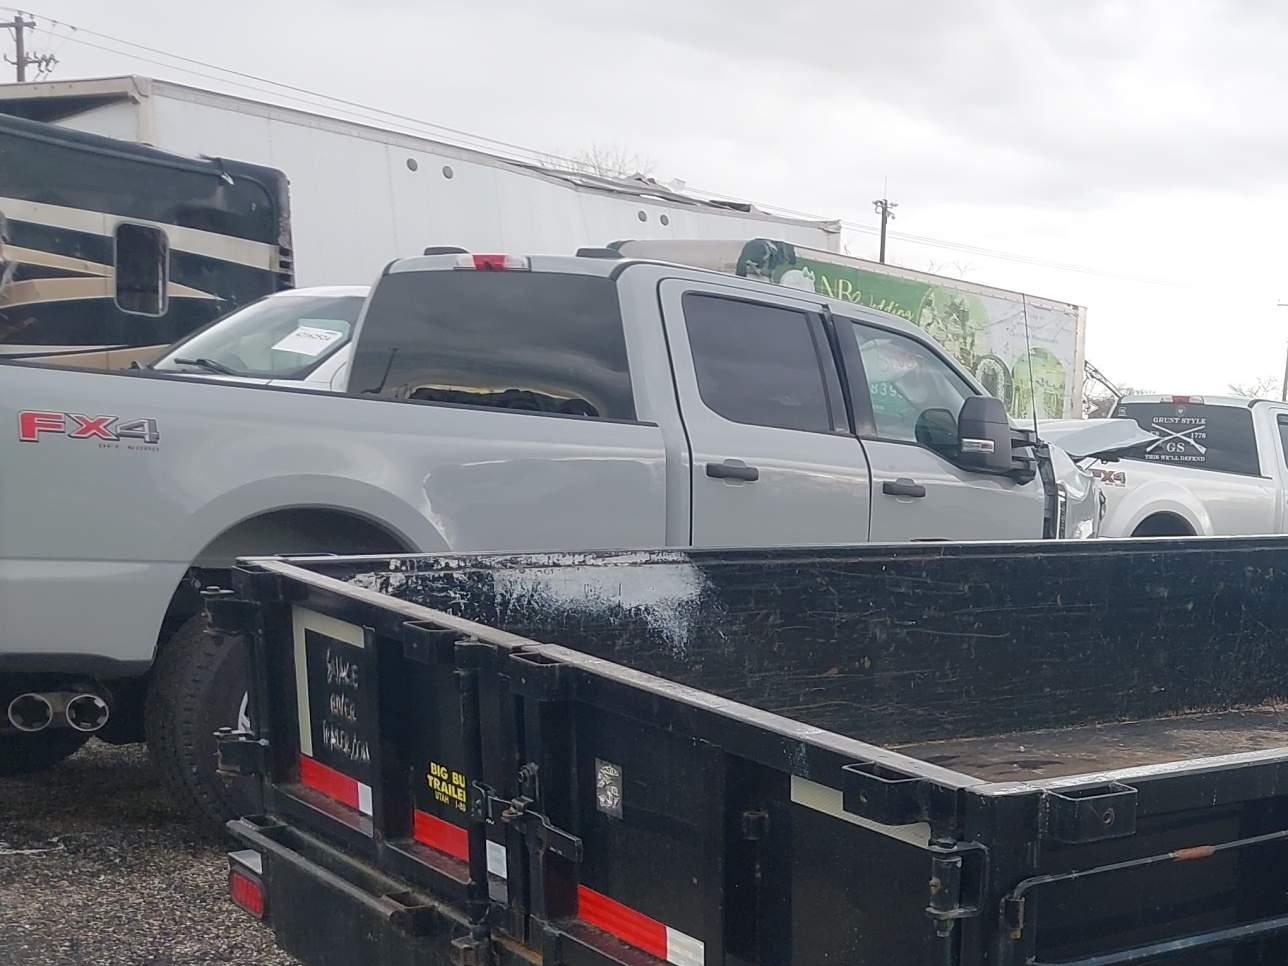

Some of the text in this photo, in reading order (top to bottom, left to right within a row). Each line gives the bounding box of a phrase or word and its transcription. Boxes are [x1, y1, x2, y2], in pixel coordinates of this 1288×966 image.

[18, 410, 160, 444] FX4
[1166, 442, 1185, 453] GS
[427, 774, 467, 803] TRAILE
[430, 761, 466, 788] BIG BU
